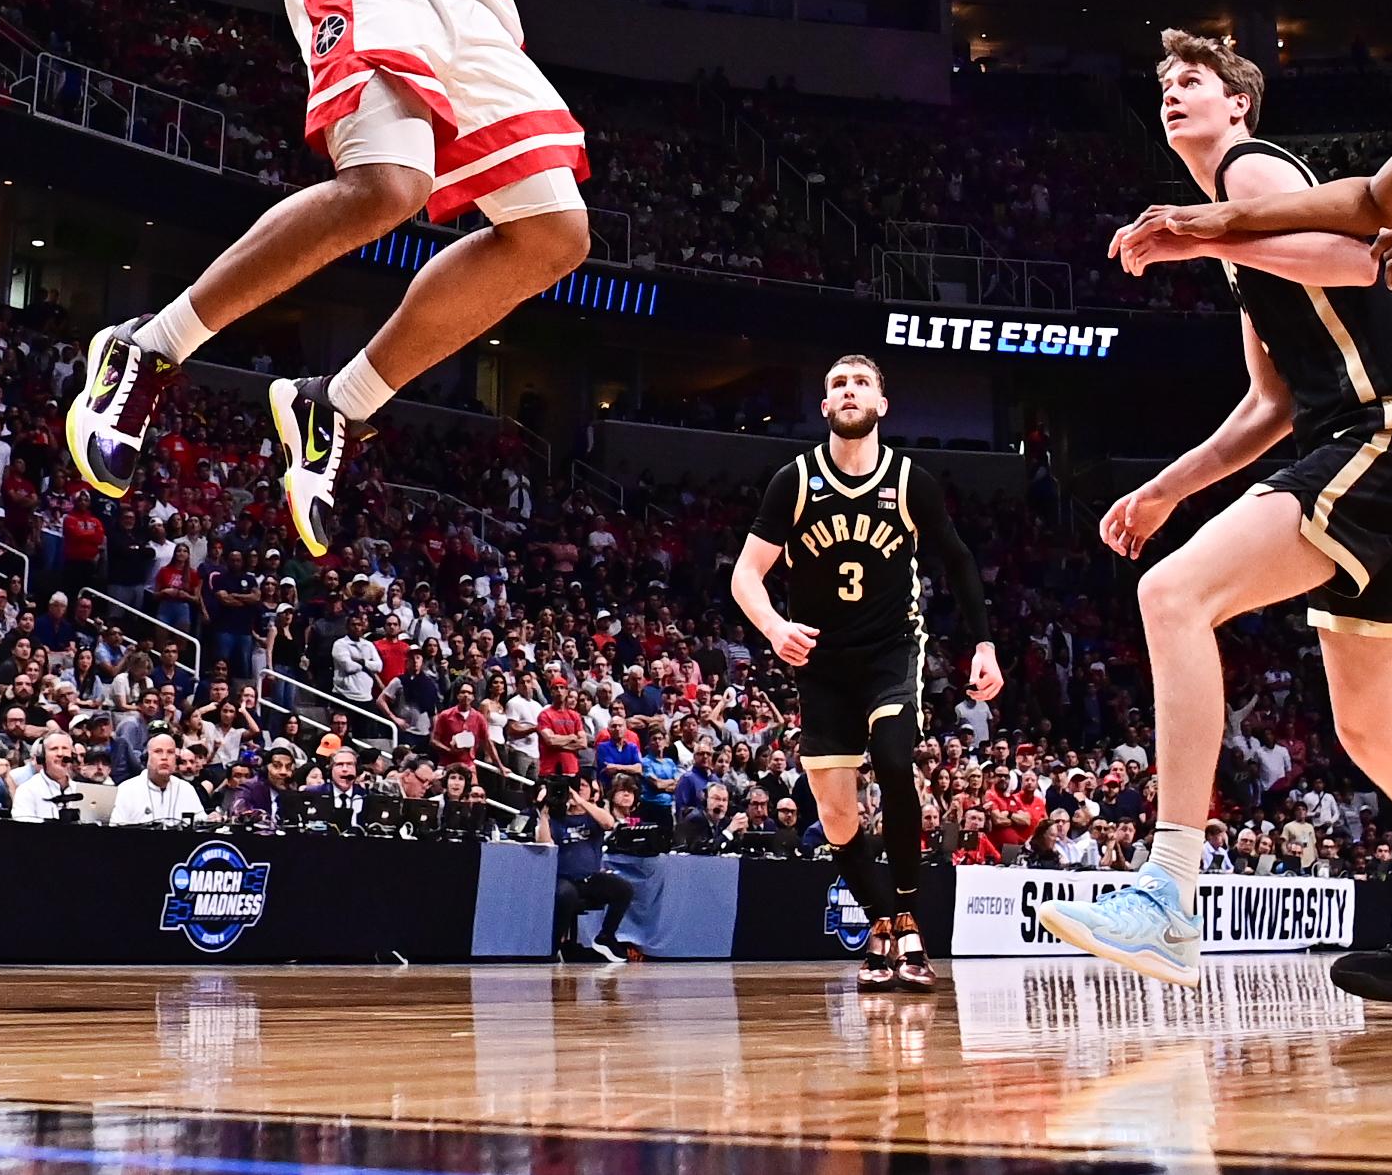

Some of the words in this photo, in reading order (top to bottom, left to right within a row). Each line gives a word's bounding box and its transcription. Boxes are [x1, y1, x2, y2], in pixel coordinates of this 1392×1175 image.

[886, 313, 993, 352] ELITE
[997, 322, 1119, 358] EIGHT
[800, 513, 904, 559] PURDUE
[838, 561, 864, 602] 3
[188, 870, 243, 893] MARCH
[193, 893, 263, 916] MADNESS
[967, 896, 1003, 916] HOSTED
[1004, 897, 1016, 917] BY
[1231, 885, 1348, 941] UNIVERSITY
